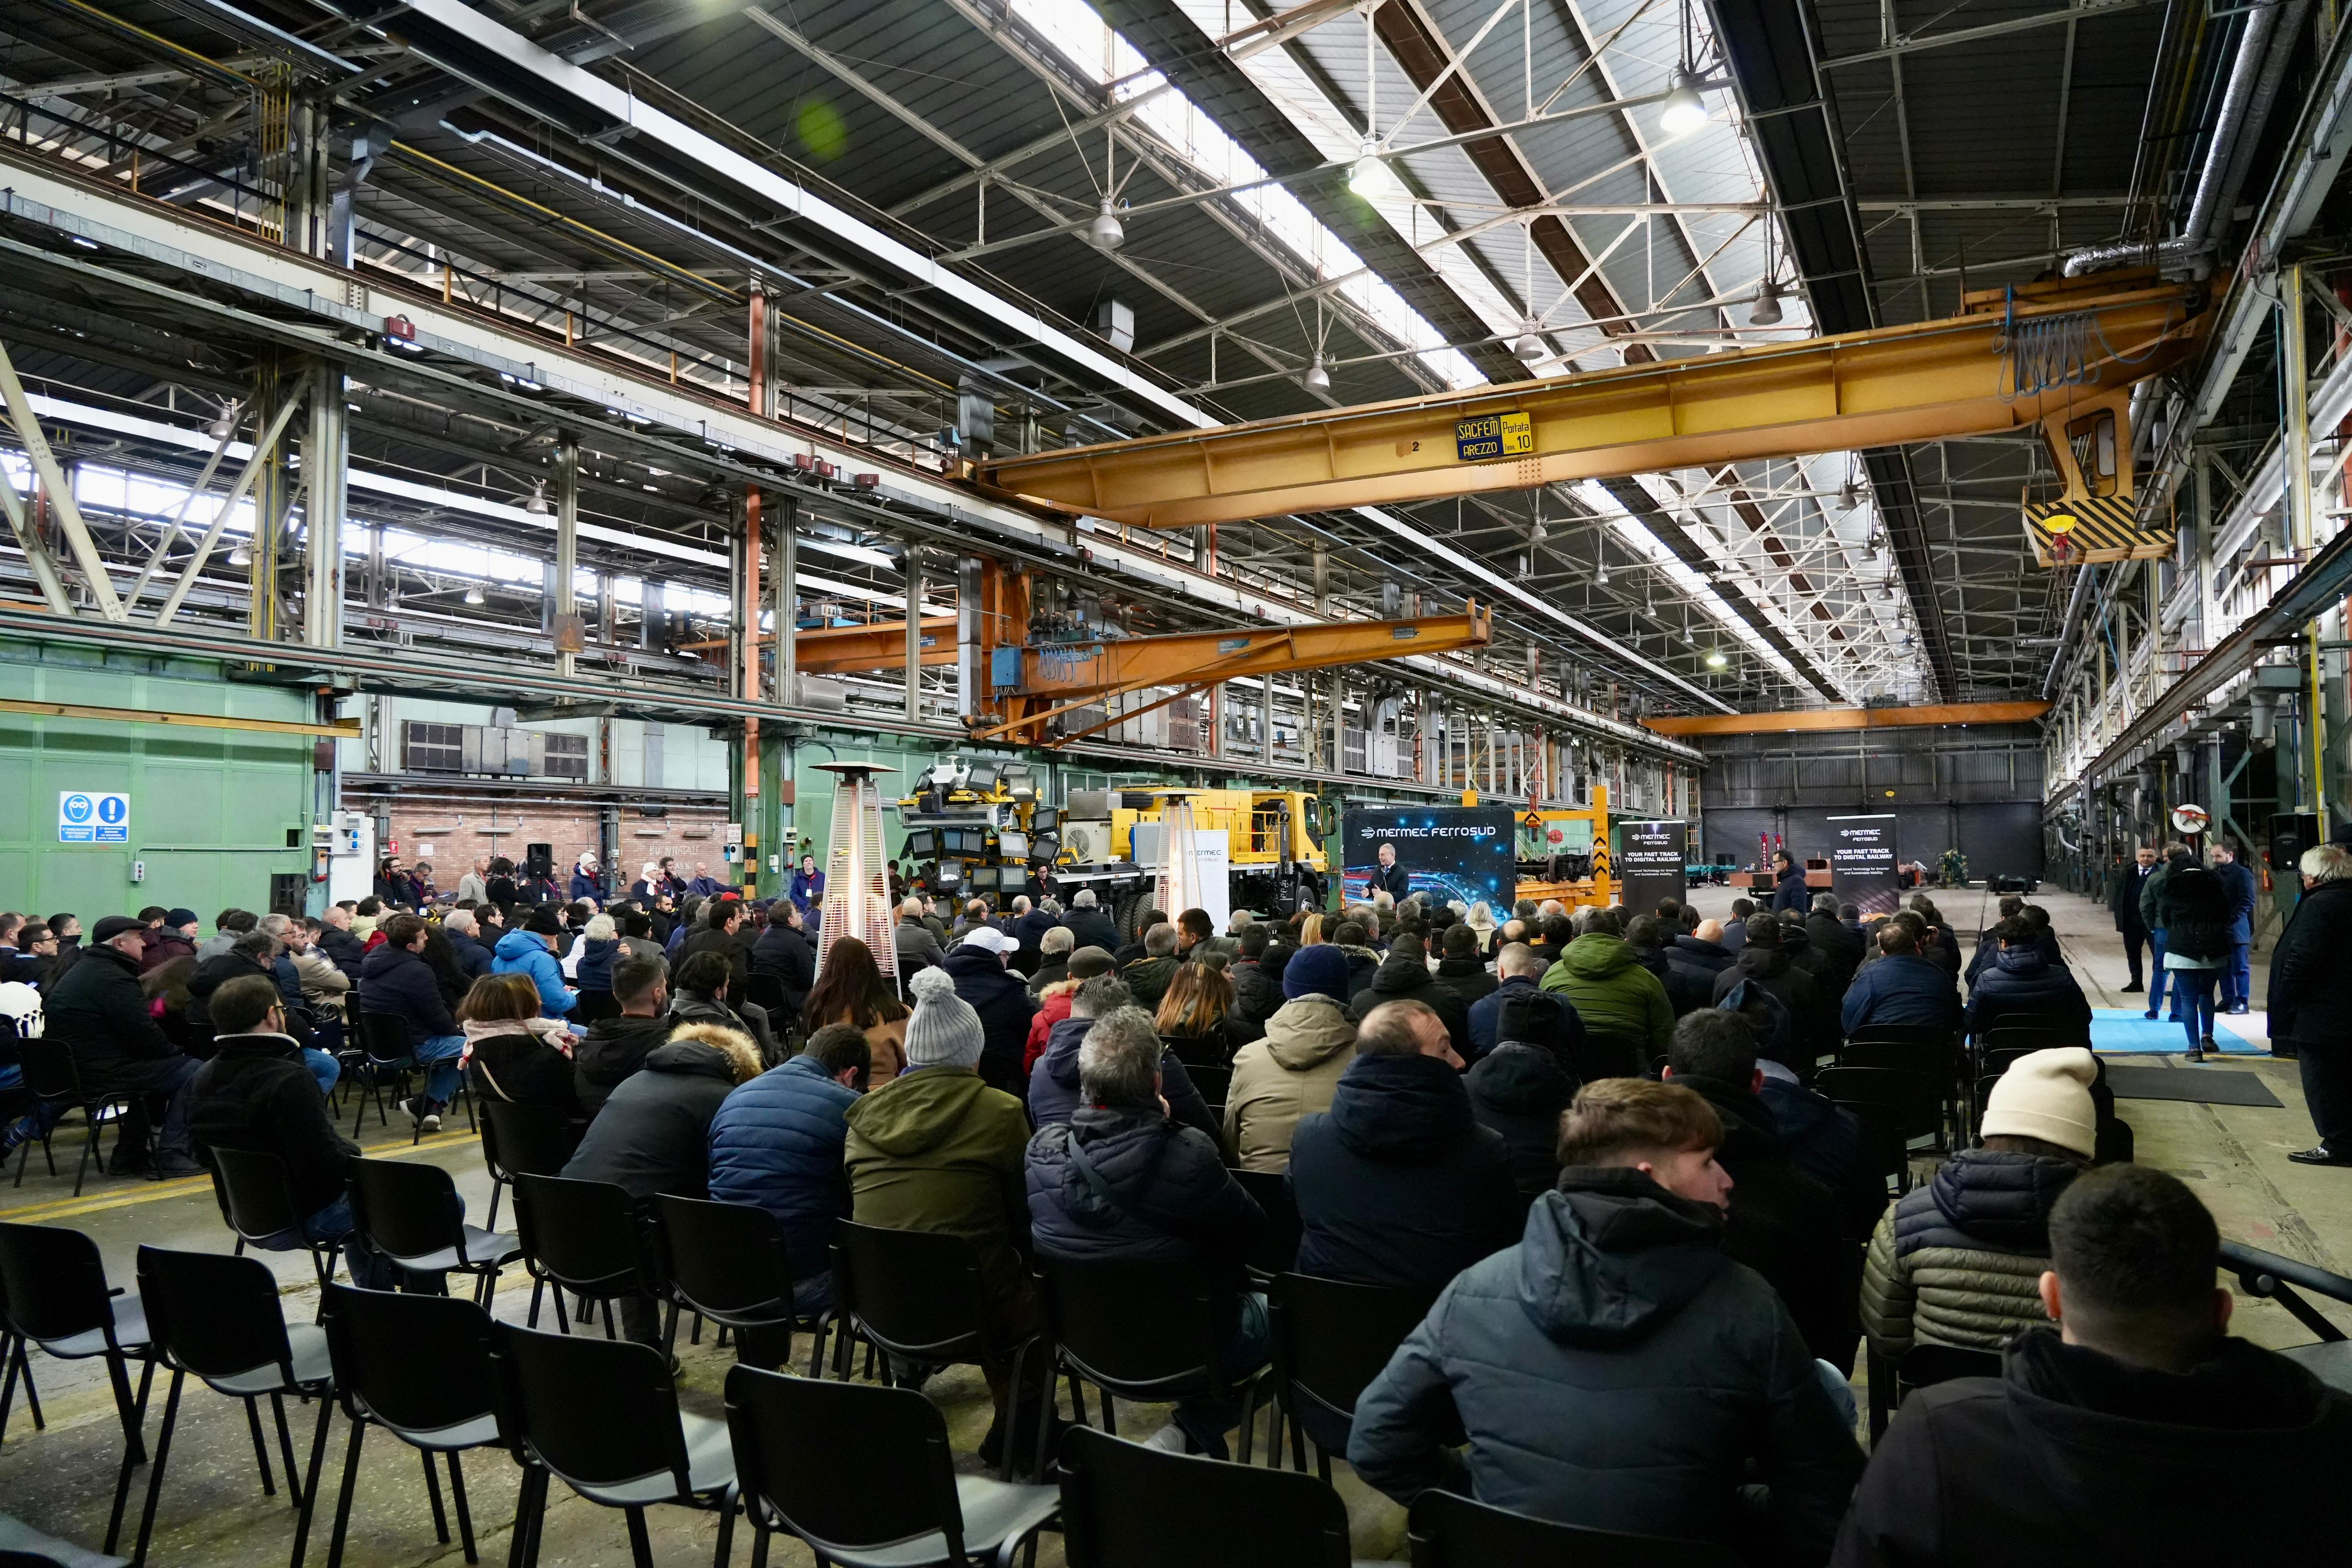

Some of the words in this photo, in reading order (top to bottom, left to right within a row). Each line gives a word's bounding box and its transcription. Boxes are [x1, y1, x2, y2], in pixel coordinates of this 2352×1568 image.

[1459, 420, 1499, 439] SACFEM
[1503, 422, 1529, 434] Portata
[1412, 442, 1419, 451] 2
[1517, 435, 1530, 449] 10
[1463, 442, 1498, 457] AREZZO
